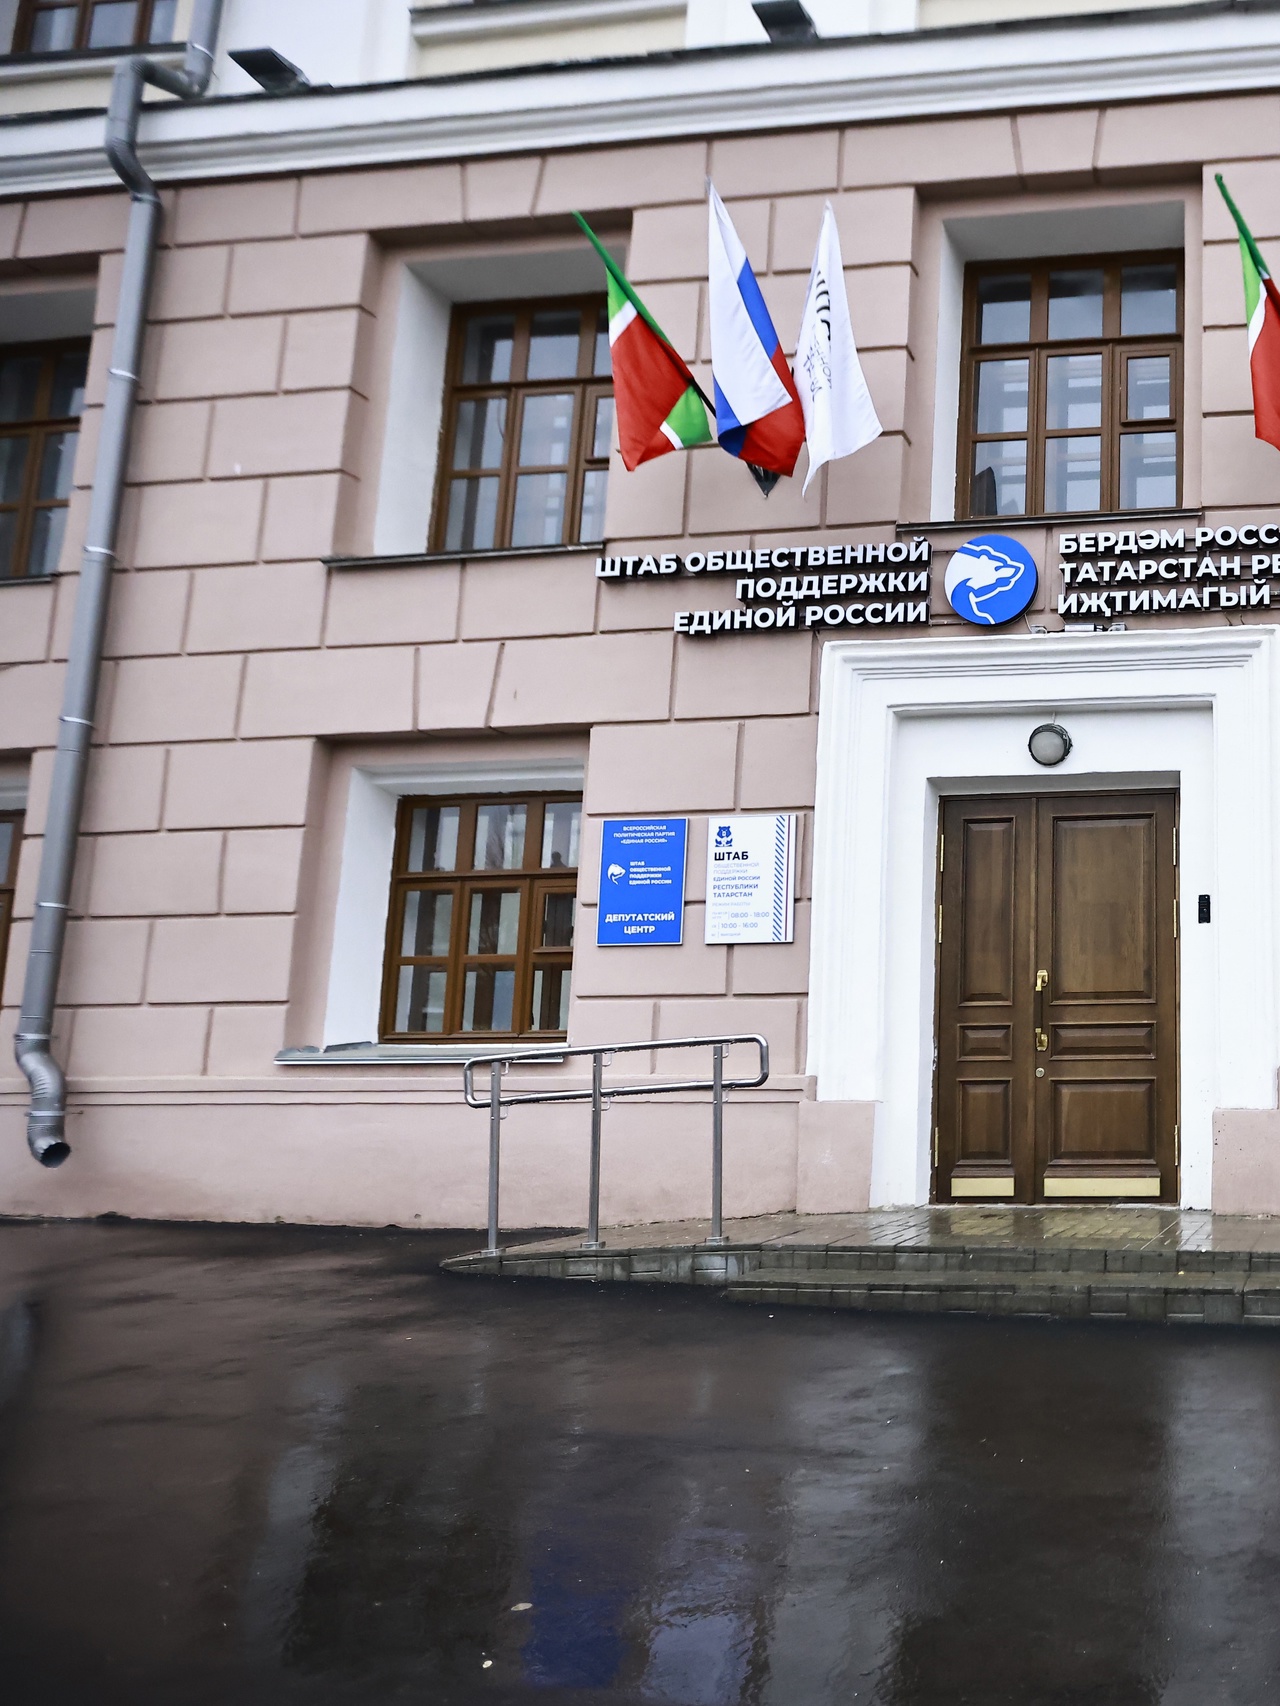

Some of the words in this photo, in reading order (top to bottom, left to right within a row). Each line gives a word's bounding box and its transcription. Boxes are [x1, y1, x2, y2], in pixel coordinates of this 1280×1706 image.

[1059, 528, 1185, 555] БЕРДӘМ
[595, 553, 678, 578] ШТАБ
[684, 536, 930, 574] ОБЩЕСТВЕННОЙ
[1059, 555, 1242, 584] ТАТАРСТАН
[736, 571, 928, 601] ПОДДЕРЖКИ
[1057, 579, 1271, 618] ИҖТИМАГЫЙ
[673, 600, 796, 635] ЕДИНОЙ
[805, 602, 928, 626] РОССИИ
[714, 851, 749, 861] ШТАБ
[605, 911, 675, 923] ДЕПУТАТСКИЙ
[624, 926, 656, 934] ЦЕНТР
